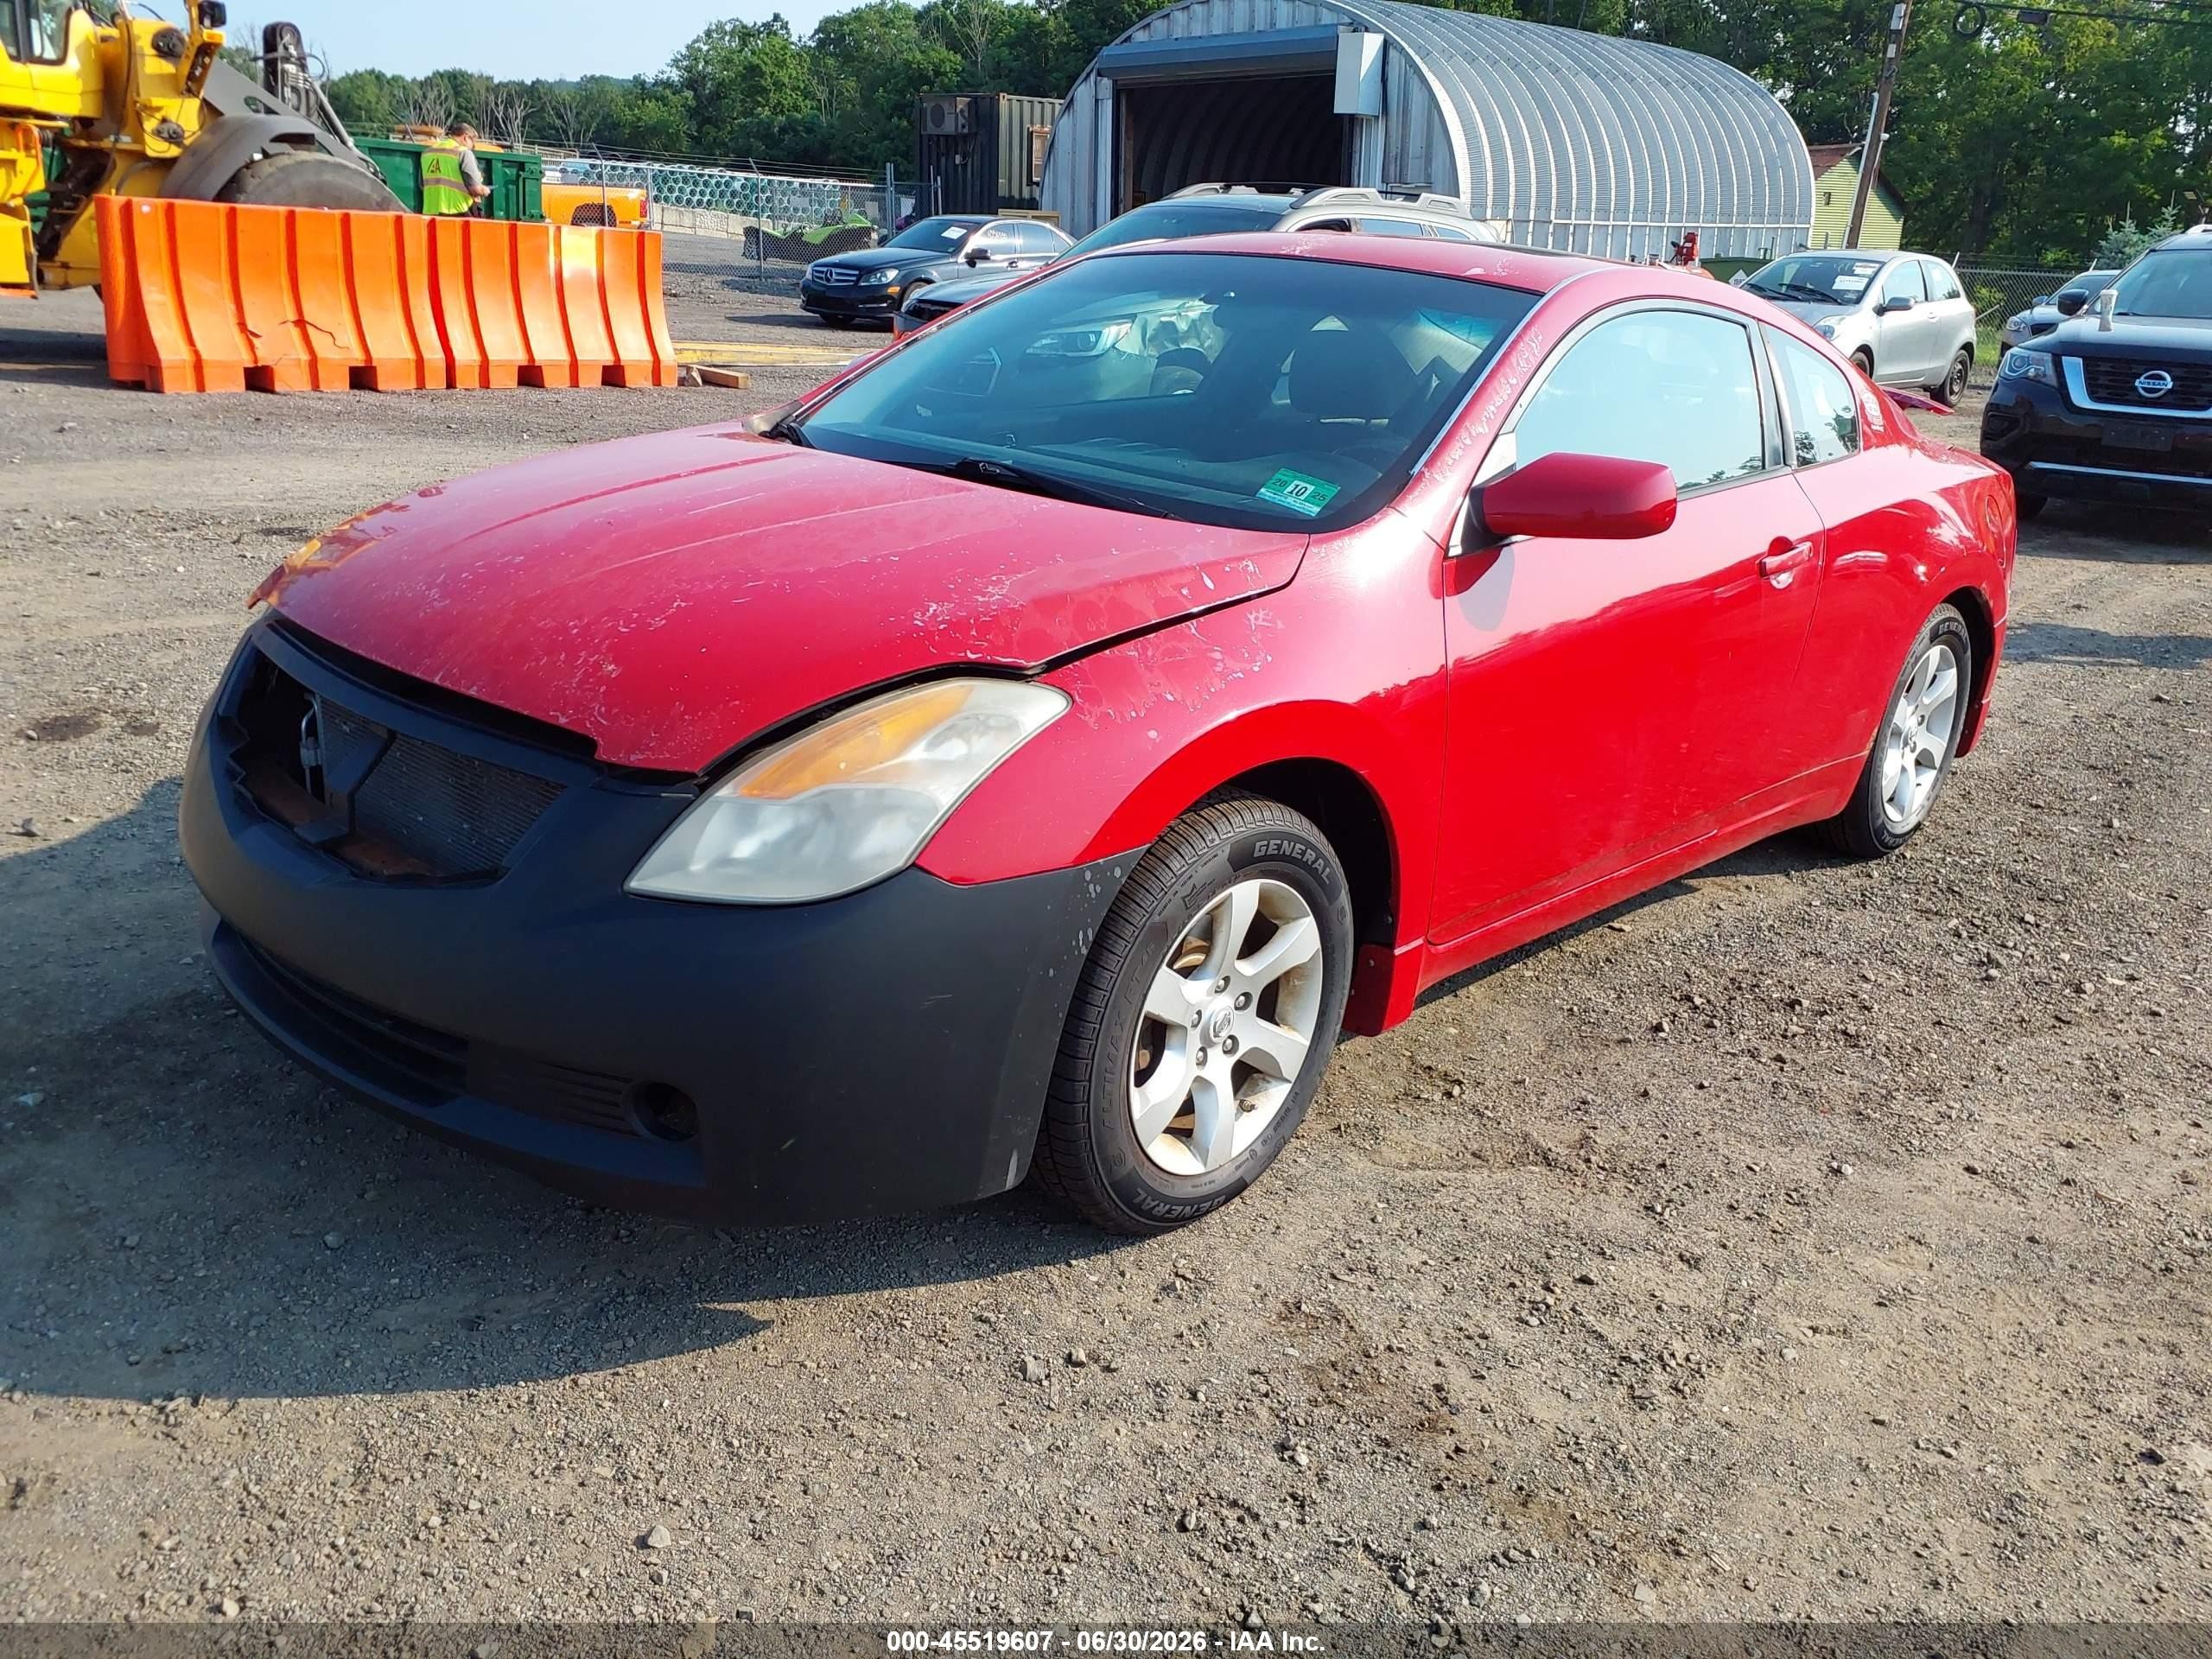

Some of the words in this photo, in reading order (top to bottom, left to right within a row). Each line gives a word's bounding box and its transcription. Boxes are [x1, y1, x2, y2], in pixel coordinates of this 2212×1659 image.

[1272, 478, 1287, 488] 20
[1287, 484, 1308, 498] 10
[1312, 491, 1328, 502] 25
[1253, 839, 1331, 886] GENERAL
[1132, 1187, 1227, 1219] GENERAL
